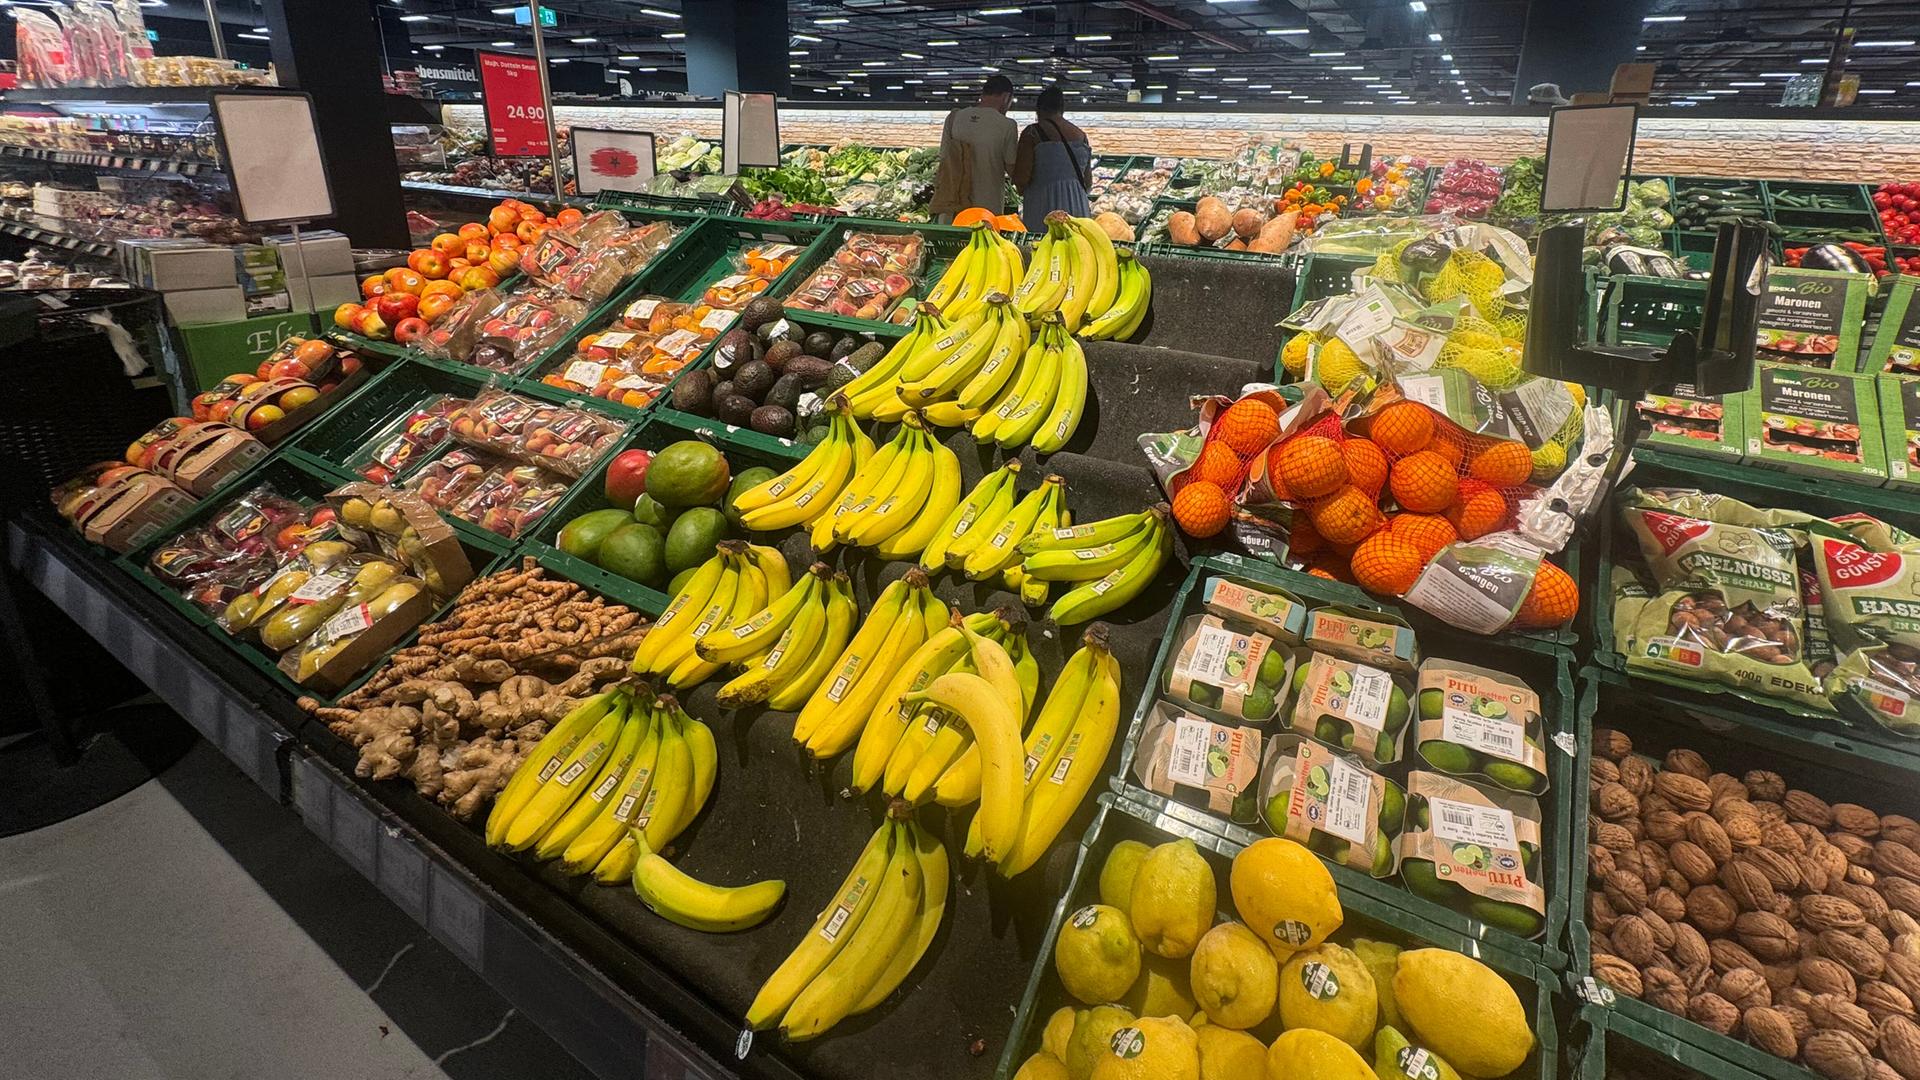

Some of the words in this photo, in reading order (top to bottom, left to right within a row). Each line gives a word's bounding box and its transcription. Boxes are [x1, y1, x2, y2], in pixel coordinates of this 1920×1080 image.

[507, 105, 545, 119] 24.90
[1797, 281, 1833, 294] Bio
[1774, 295, 1822, 309] Maronen
[1802, 377, 1840, 389] Bio
[1781, 387, 1831, 401] Maronen
[1720, 445, 1734, 453] 200
[1735, 447, 1741, 455] g
[1862, 466, 1878, 475] 200
[1879, 469, 1885, 477] g
[1682, 553, 1792, 586] HAELNÜSSE
[1732, 579, 1772, 591] SCHALE
[1894, 621, 1909, 630] IN
